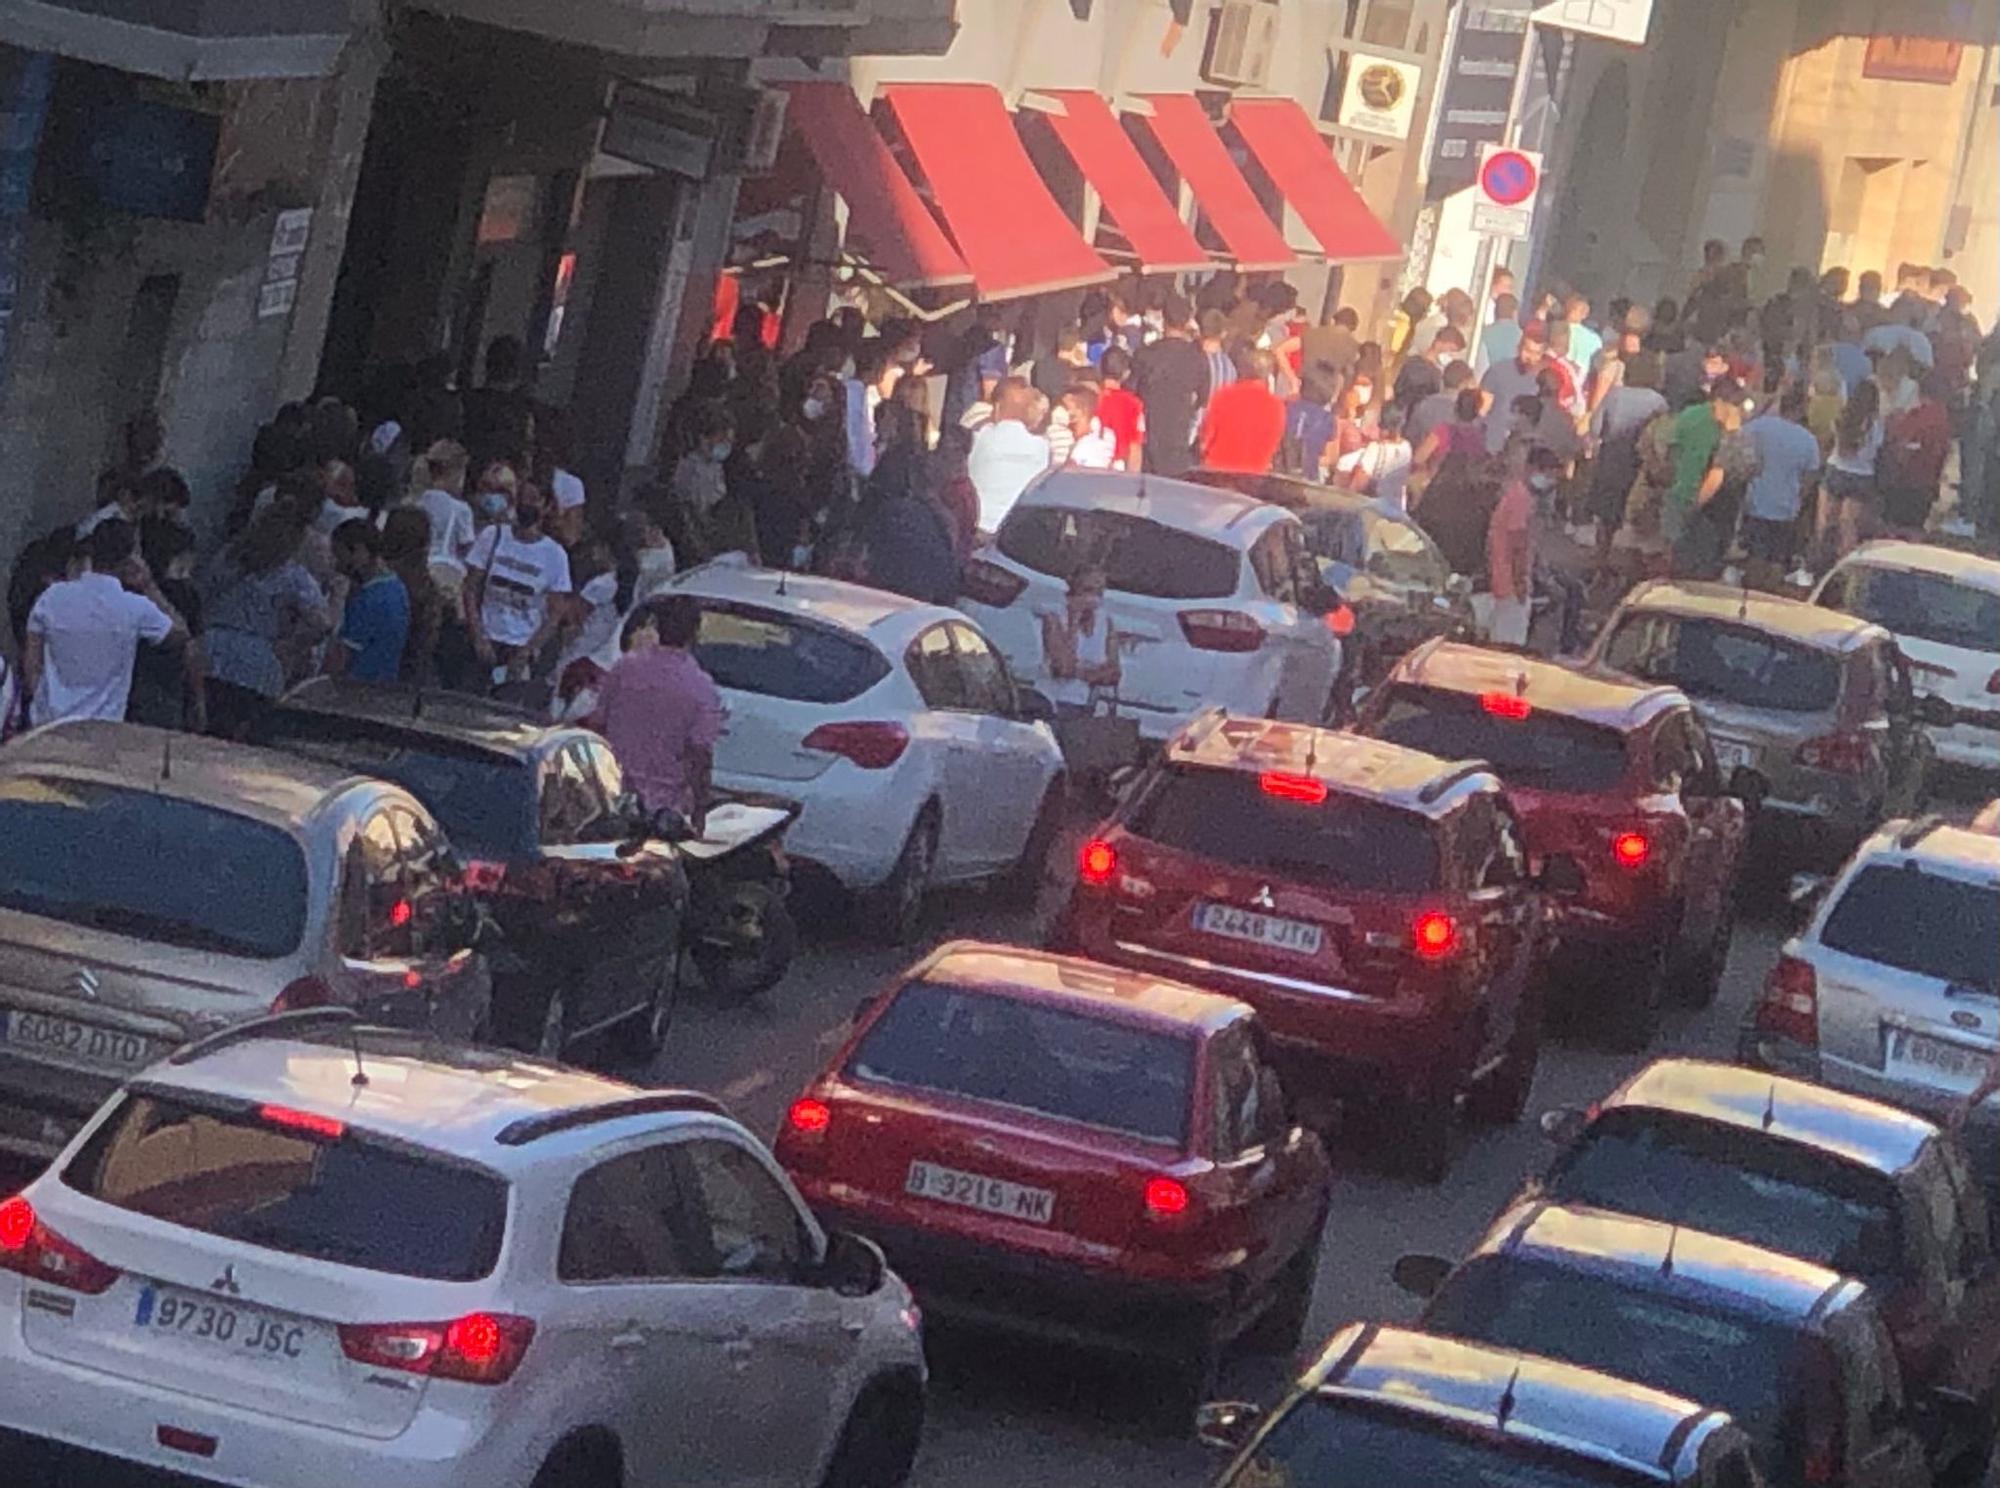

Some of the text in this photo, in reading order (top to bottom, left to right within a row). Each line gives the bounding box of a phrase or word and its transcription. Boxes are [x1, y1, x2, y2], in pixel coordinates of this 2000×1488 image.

[18, 1014, 83, 1051] 6082
[157, 1298, 304, 1359] 9730 JSC
